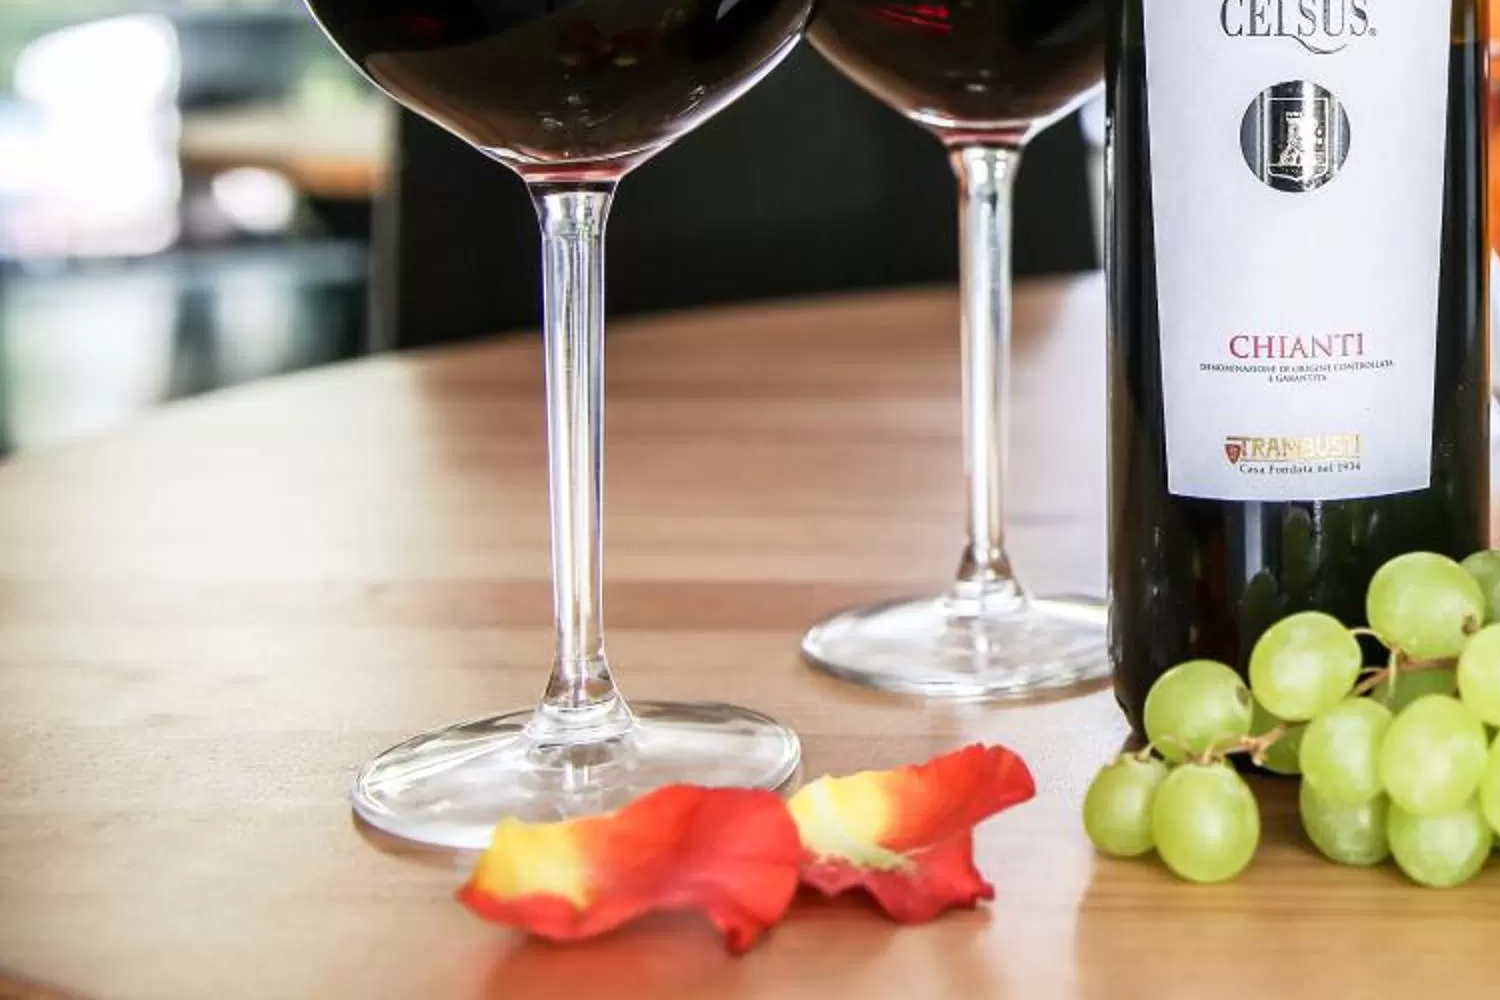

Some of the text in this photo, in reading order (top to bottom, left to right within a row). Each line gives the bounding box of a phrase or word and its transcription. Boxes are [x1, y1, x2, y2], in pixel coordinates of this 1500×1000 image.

[1229, 332, 1364, 359] CHIANTI
[1239, 463, 1265, 474] Casa
[1268, 463, 1313, 474] Fondata
